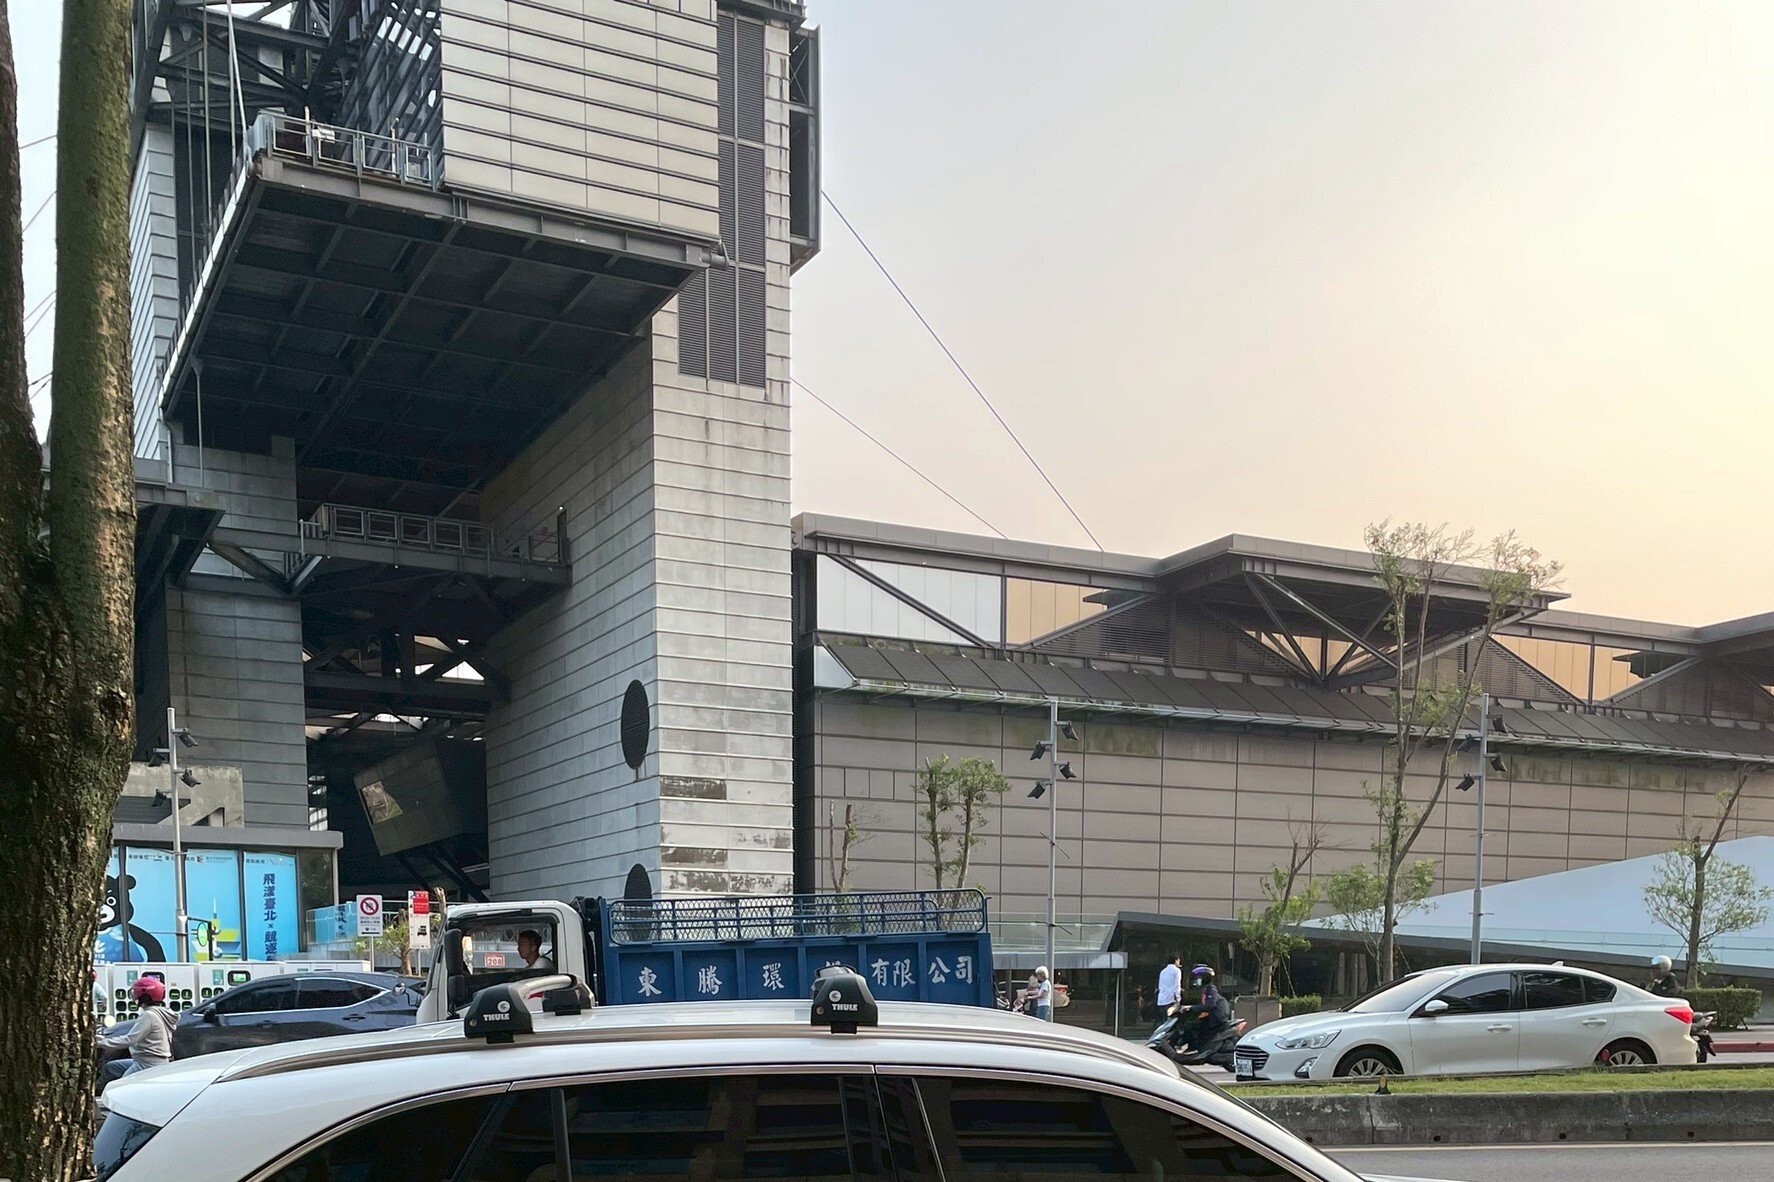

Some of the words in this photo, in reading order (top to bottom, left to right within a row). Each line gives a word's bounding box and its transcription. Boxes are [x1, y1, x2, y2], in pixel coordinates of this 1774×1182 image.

[638, 956, 974, 996] 東騰環有限公司
[831, 1003, 858, 1011] THULE
[483, 1013, 510, 1021] THULE
